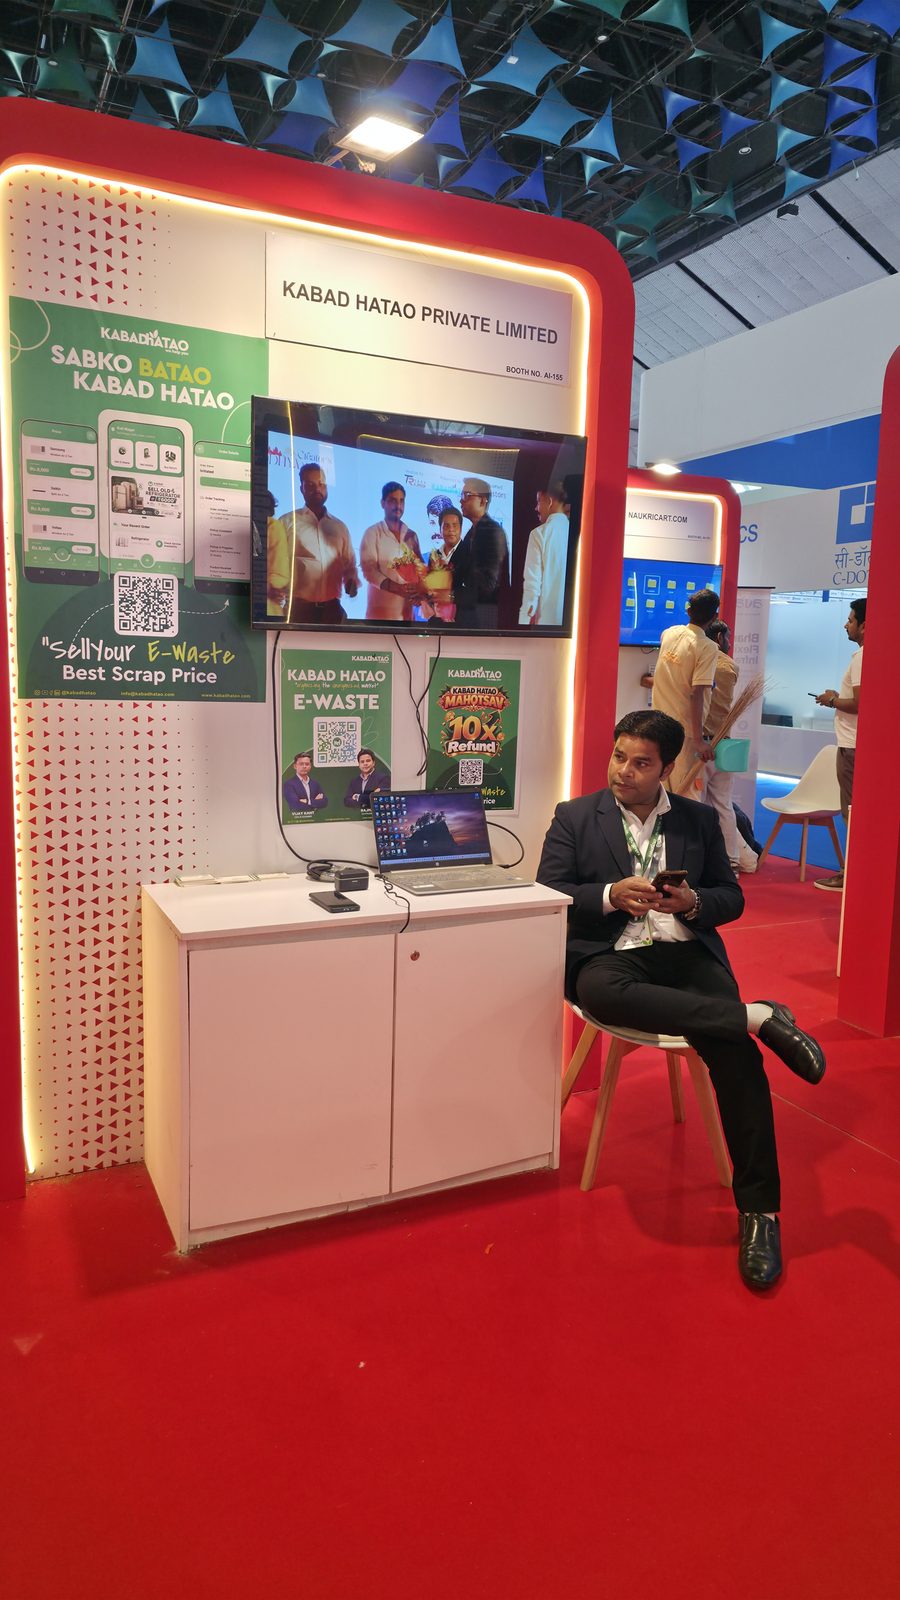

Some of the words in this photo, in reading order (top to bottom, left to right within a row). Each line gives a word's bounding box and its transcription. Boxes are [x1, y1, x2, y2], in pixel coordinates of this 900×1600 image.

[283, 280, 350, 308] KABAD
[356, 294, 416, 320] HATAO
[422, 306, 490, 333] PRIVATE
[496, 320, 558, 344] LIMITED
[51, 345, 132, 373] SABKO
[139, 358, 211, 385] BATAO
[506, 365, 530, 376] BOOTH
[530, 370, 542, 378] NO.
[544, 372, 563, 381] AI-155
[74, 371, 154, 399] KABAD
[161, 384, 234, 410] HATAO
[628, 512, 688, 523] NAUKRICART.COM
[833, 570, 869, 585] C-DO
[148, 640, 235, 664] E-Waste
[63, 665, 106, 681] Best
[112, 667, 166, 685] Scrap
[172, 668, 217, 684] Price
[288, 669, 336, 681] KABAD
[341, 670, 386, 682] HATAO
[294, 694, 379, 710] E-WASTE
[445, 694, 505, 708] MAHOTSAV
[447, 741, 496, 753] Refund
